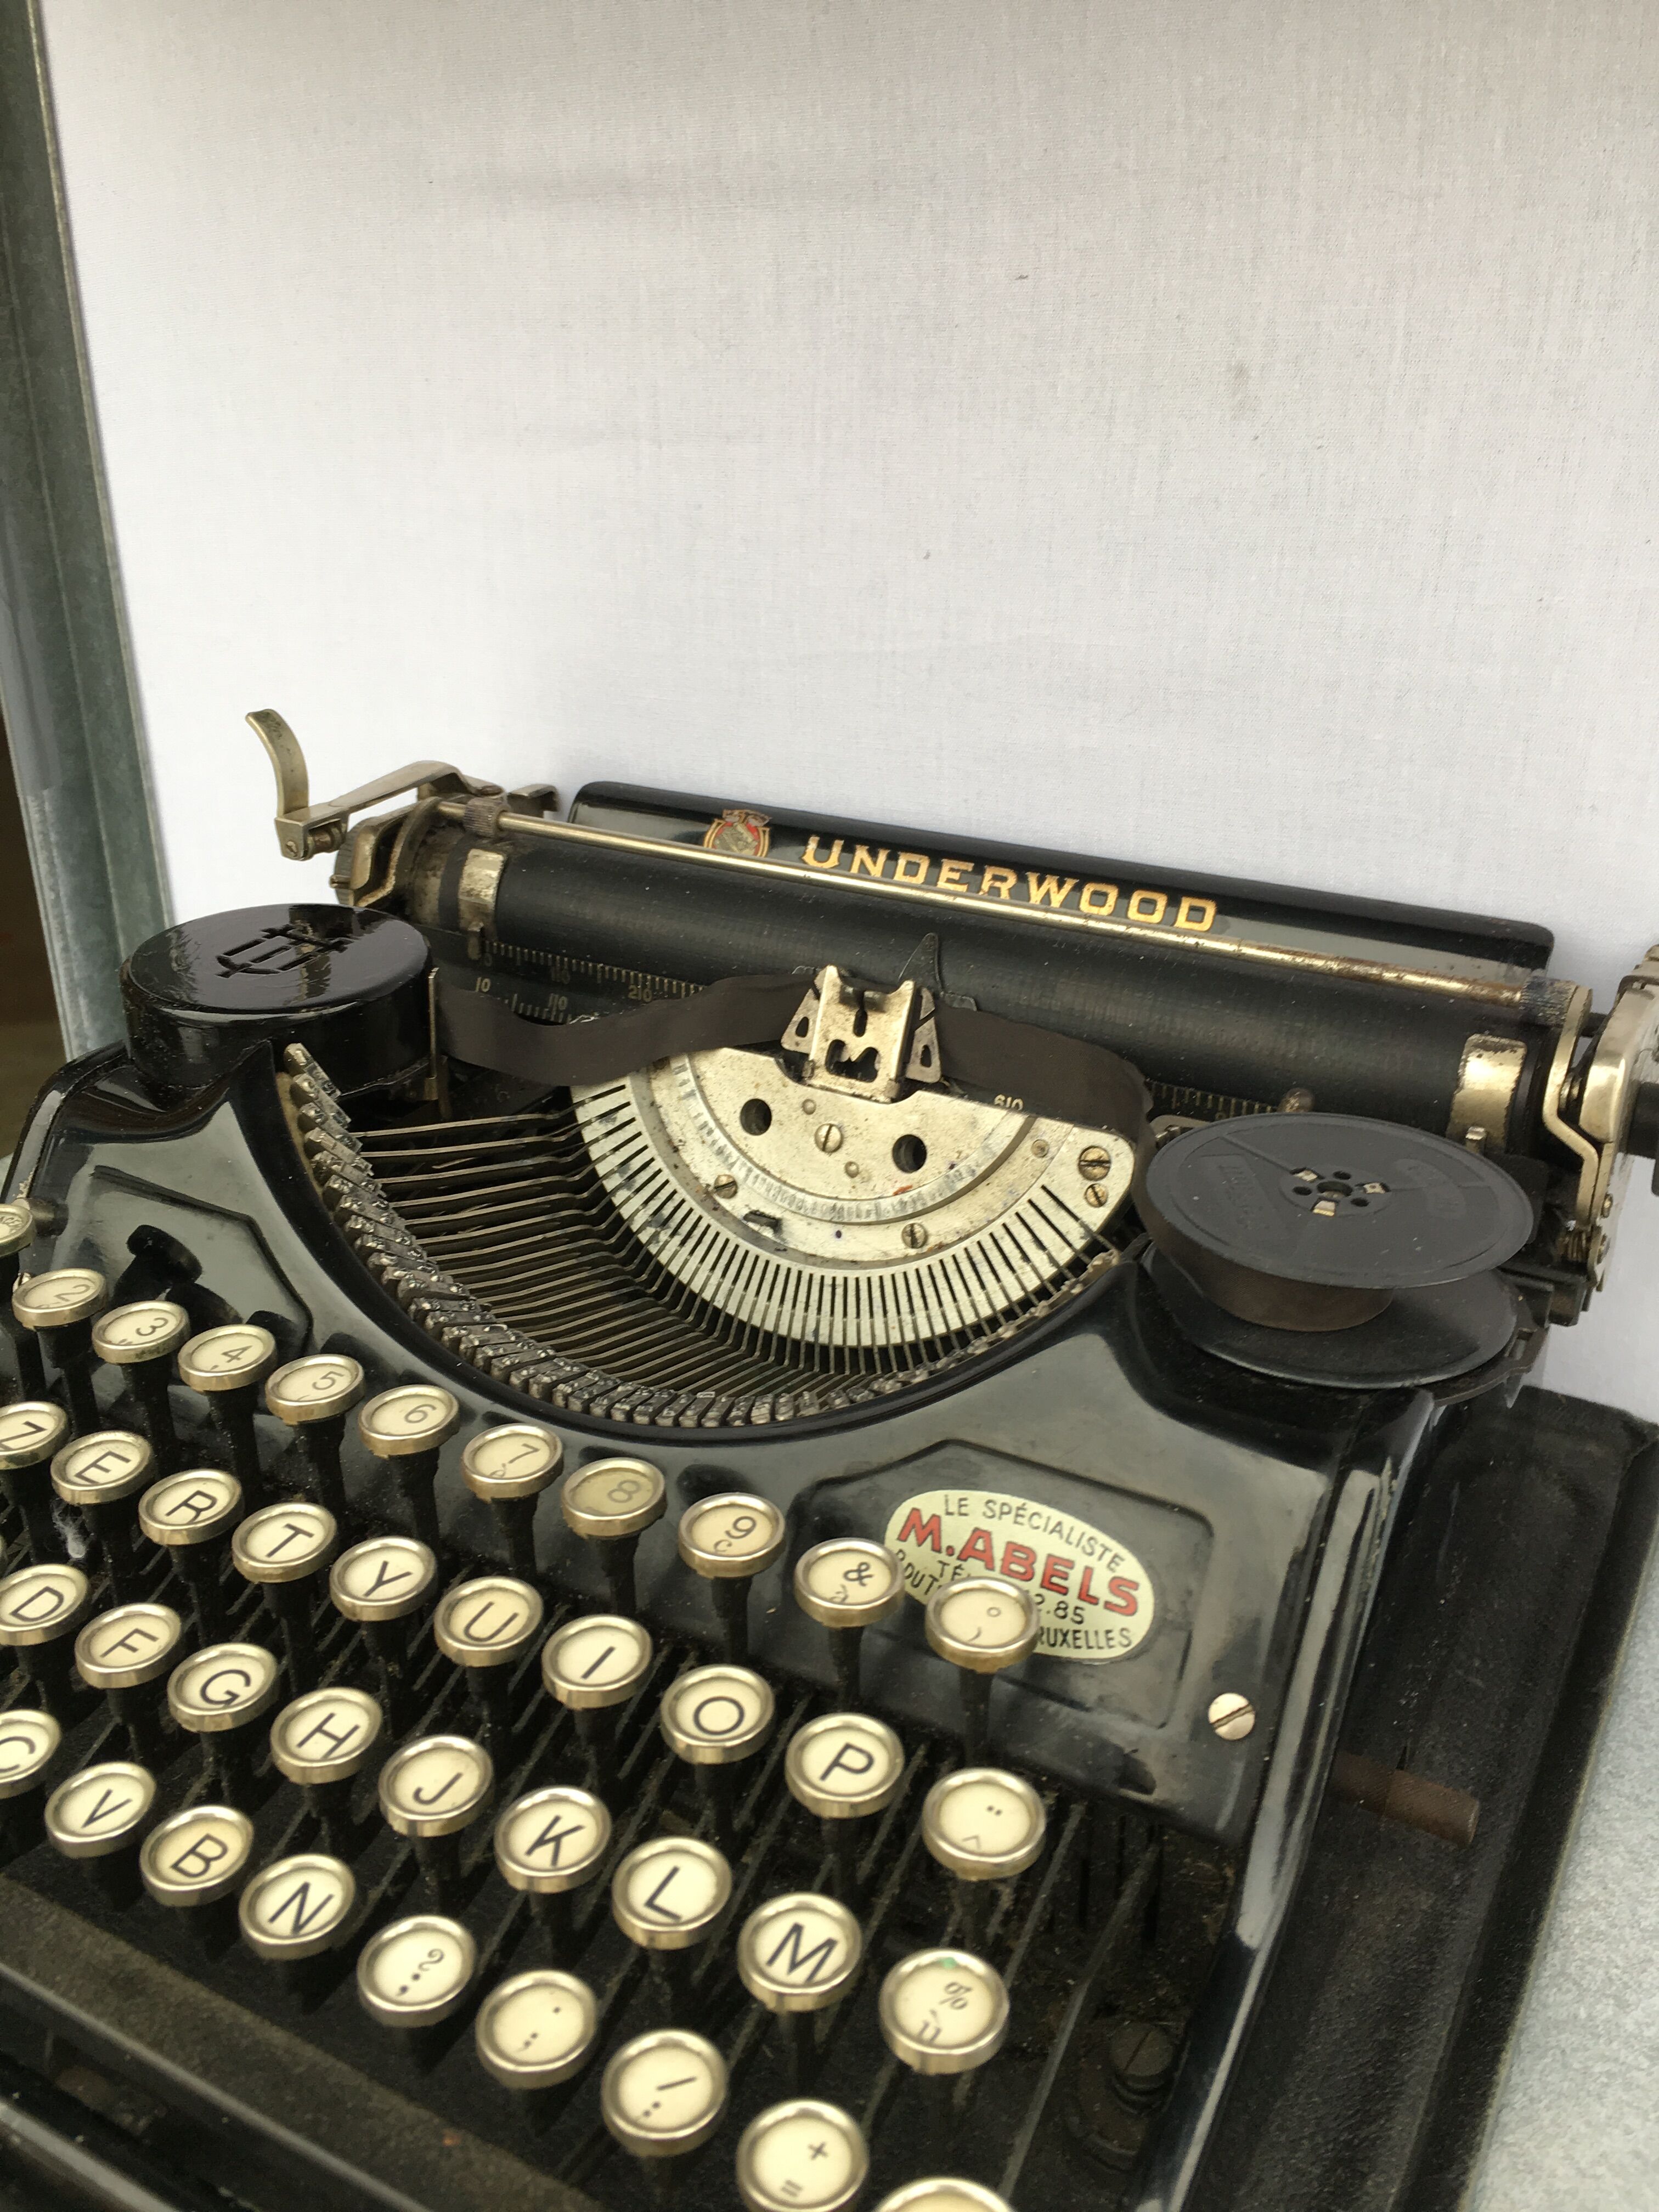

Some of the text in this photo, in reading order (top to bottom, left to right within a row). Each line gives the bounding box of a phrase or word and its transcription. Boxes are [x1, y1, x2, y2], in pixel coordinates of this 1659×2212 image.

[802, 834, 1217, 933] UNDERWOOD
[54, 1284, 91, 1302] 2
[136, 1317, 168, 1336] 3
[221, 1345, 253, 1363] 4
[311, 1370, 344, 1391] 5
[404, 1403, 437, 1424] 6
[74, 1451, 131, 1485] E
[507, 1443, 540, 1464] 7
[165, 1490, 217, 1522] R
[607, 1480, 640, 1503] 8
[266, 1522, 315, 1558] T
[724, 1515, 757, 1539] 9
[944, 1494, 1126, 1573] LE SPÉCIALISTE
[363, 1560, 413, 1597] Y
[896, 1506, 1139, 1616] M.ABELS
[9, 1585, 65, 1623] D
[462, 1601, 520, 1642] U
[100, 1628, 160, 1658] F
[1039, 1626, 1132, 1649] RUXELLES
[580, 1646, 616, 1680] I
[200, 1668, 251, 1707] G
[692, 1695, 746, 1736] O
[296, 1712, 360, 1759] H
[819, 1742, 875, 1781] P
[412, 1772, 464, 1805] J
[82, 1788, 133, 1828] V
[170, 1833, 229, 1878] B
[524, 1814, 585, 1866] K
[268, 1881, 335, 1934] N
[644, 1865, 682, 1921] L
[765, 1922, 839, 1983] M
